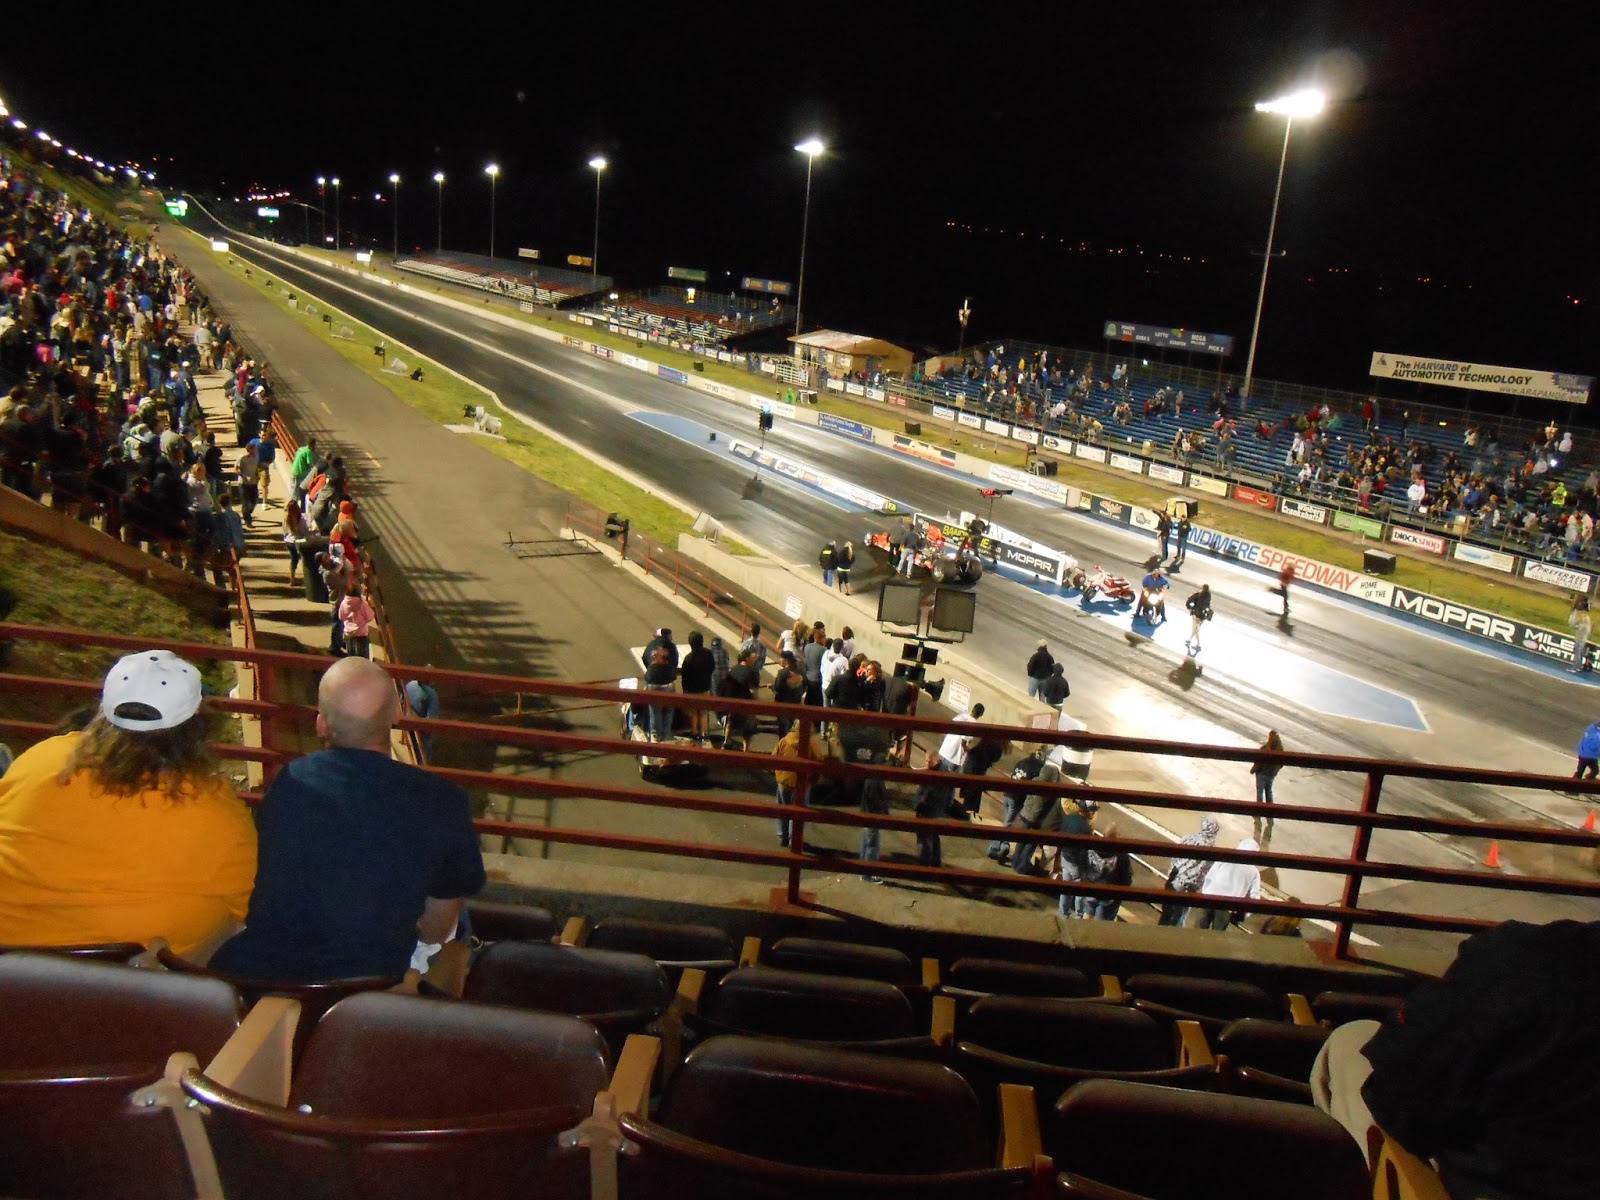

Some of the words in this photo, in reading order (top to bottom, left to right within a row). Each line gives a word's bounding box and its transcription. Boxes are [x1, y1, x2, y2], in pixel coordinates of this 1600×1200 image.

[1395, 360, 1411, 370] The
[1413, 361, 1459, 372] HARVARD
[1460, 364, 1472, 373] of
[1391, 369, 1455, 382] AUTOMOTIVE
[1458, 373, 1533, 386] TECHNOLOGY
[1394, 531, 1440, 552] blockshop
[1007, 549, 1053, 572] MOPAR
[1170, 520, 1261, 562] BNDIMERE
[1258, 547, 1359, 592] SPEEDWAY
[1536, 565, 1588, 583] PREFERRED
[1360, 580, 1379, 589] HOME
[1365, 590, 1374, 598] OF
[1375, 590, 1387, 598] THE
[1394, 589, 1516, 643] MOPAR
